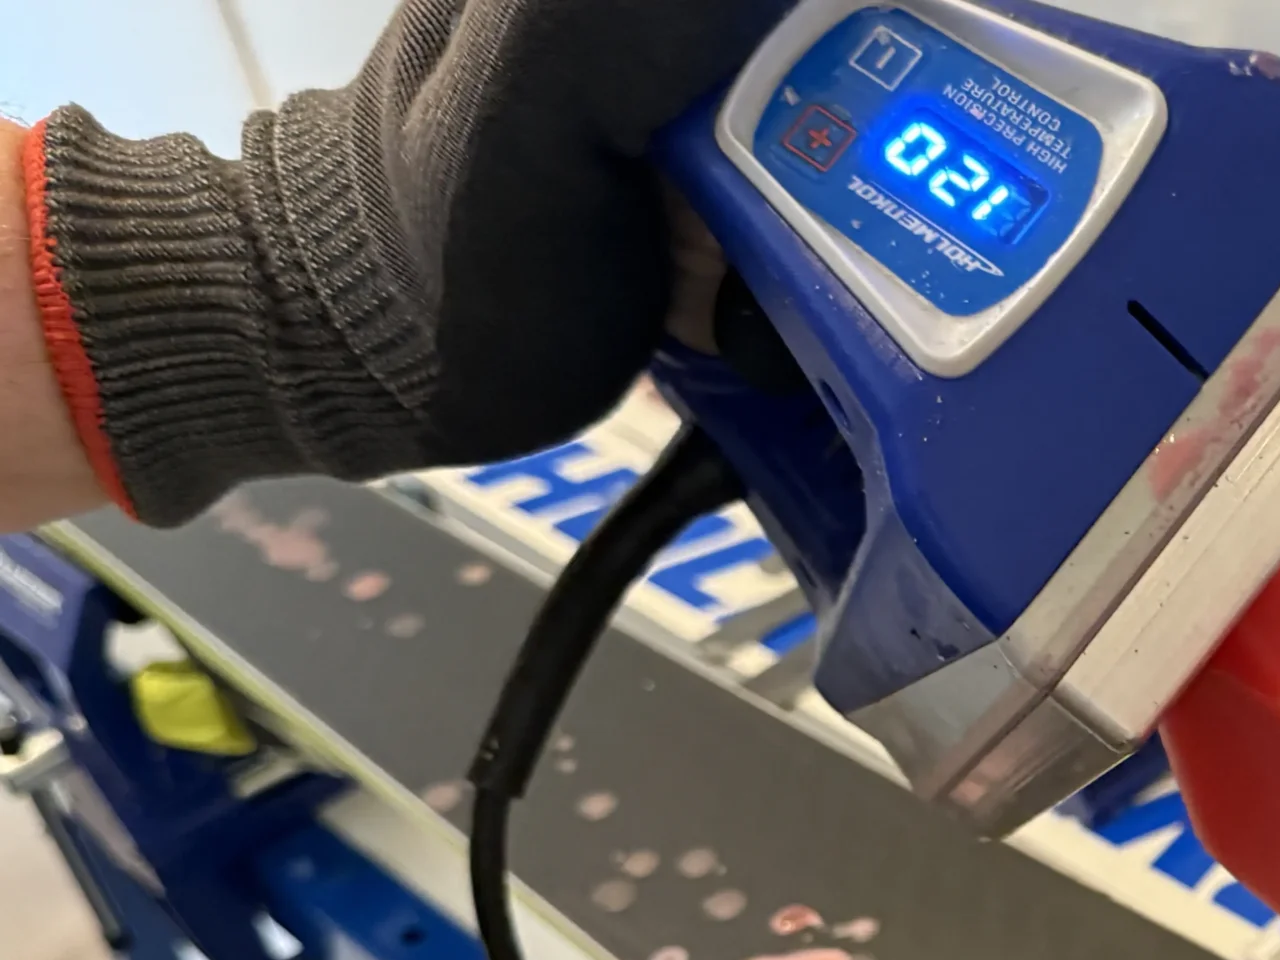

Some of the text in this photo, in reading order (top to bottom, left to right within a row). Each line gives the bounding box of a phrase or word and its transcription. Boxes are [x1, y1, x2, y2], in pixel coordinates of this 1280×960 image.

[943, 83, 1068, 174] HIGH PRECISION
[961, 77, 1073, 159] TEMPERATURE
[992, 75, 1061, 131] CONTROL
[885, 122, 1009, 221] 120
[848, 175, 983, 272] HOLMENKOL
